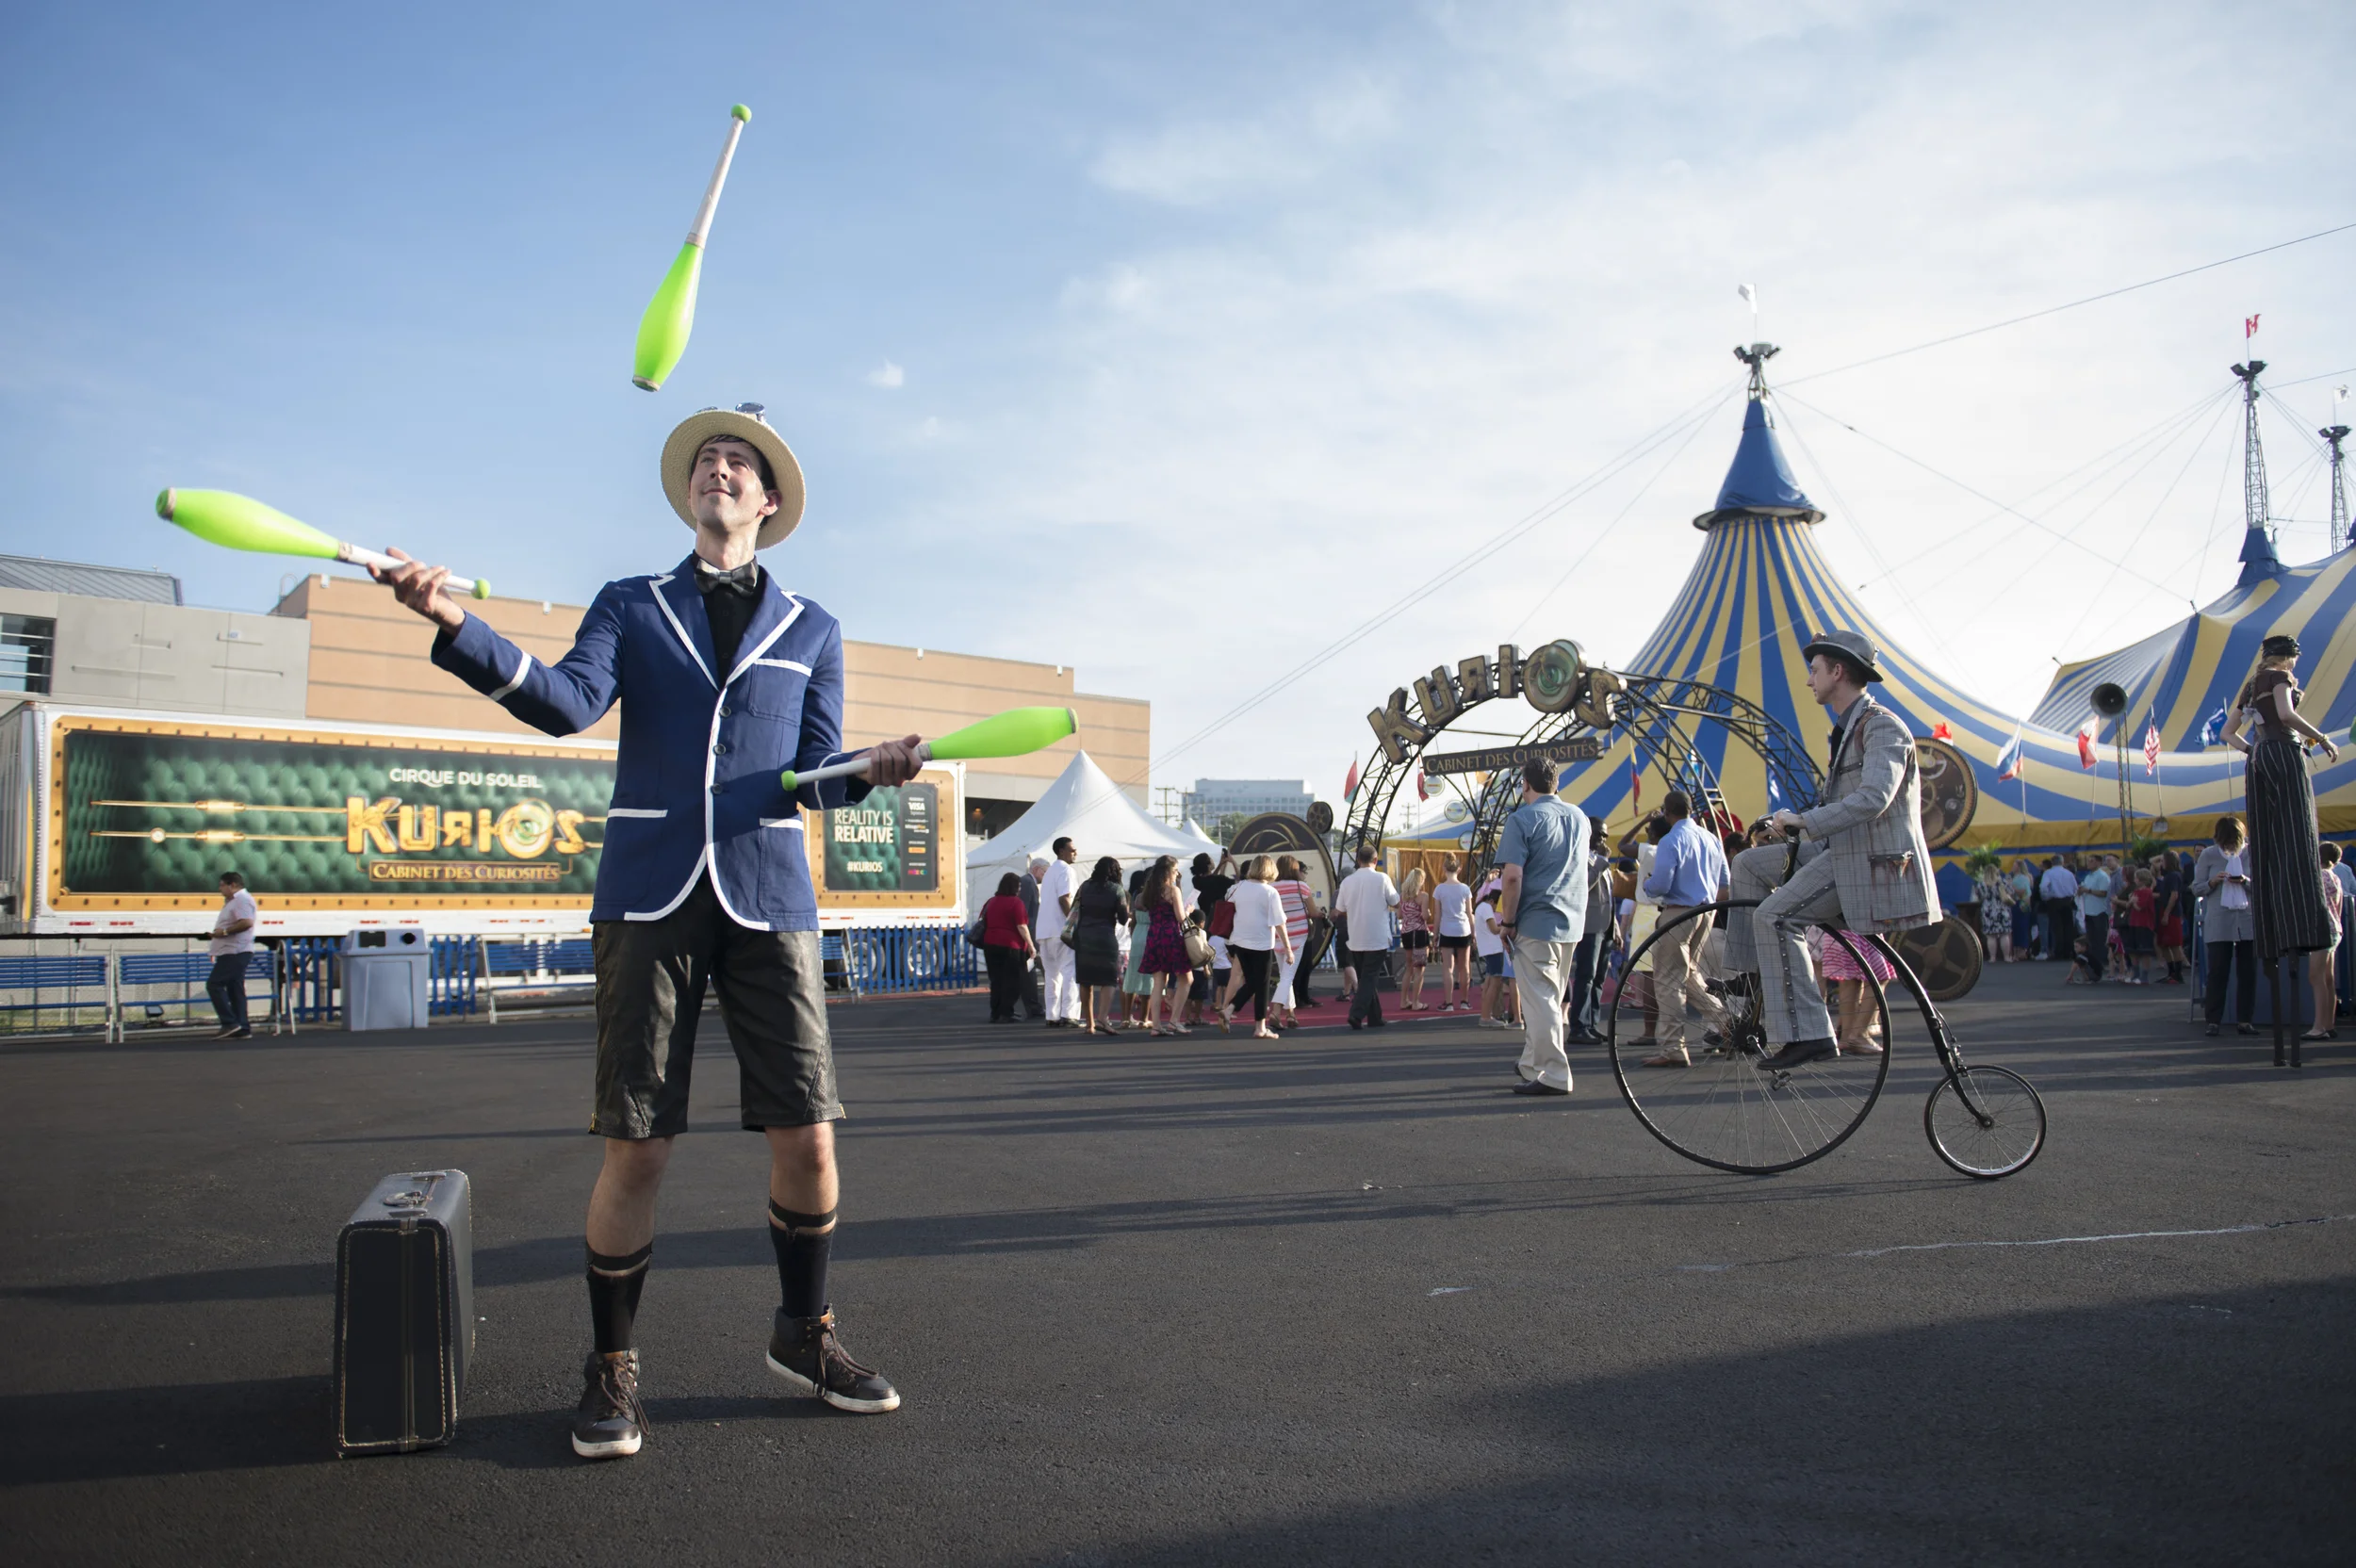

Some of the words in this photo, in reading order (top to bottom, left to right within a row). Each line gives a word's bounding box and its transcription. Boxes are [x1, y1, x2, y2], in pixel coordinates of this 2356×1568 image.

[389, 768, 454, 788] CIRQUE
[458, 771, 483, 786] DU
[485, 773, 542, 789] SOLEIL
[908, 802, 925, 811] VISA
[834, 808, 881, 825] REALITY
[882, 809, 893, 826] IS
[834, 826, 894, 843] RELATIVE
[846, 861, 883, 874] #KURIOS
